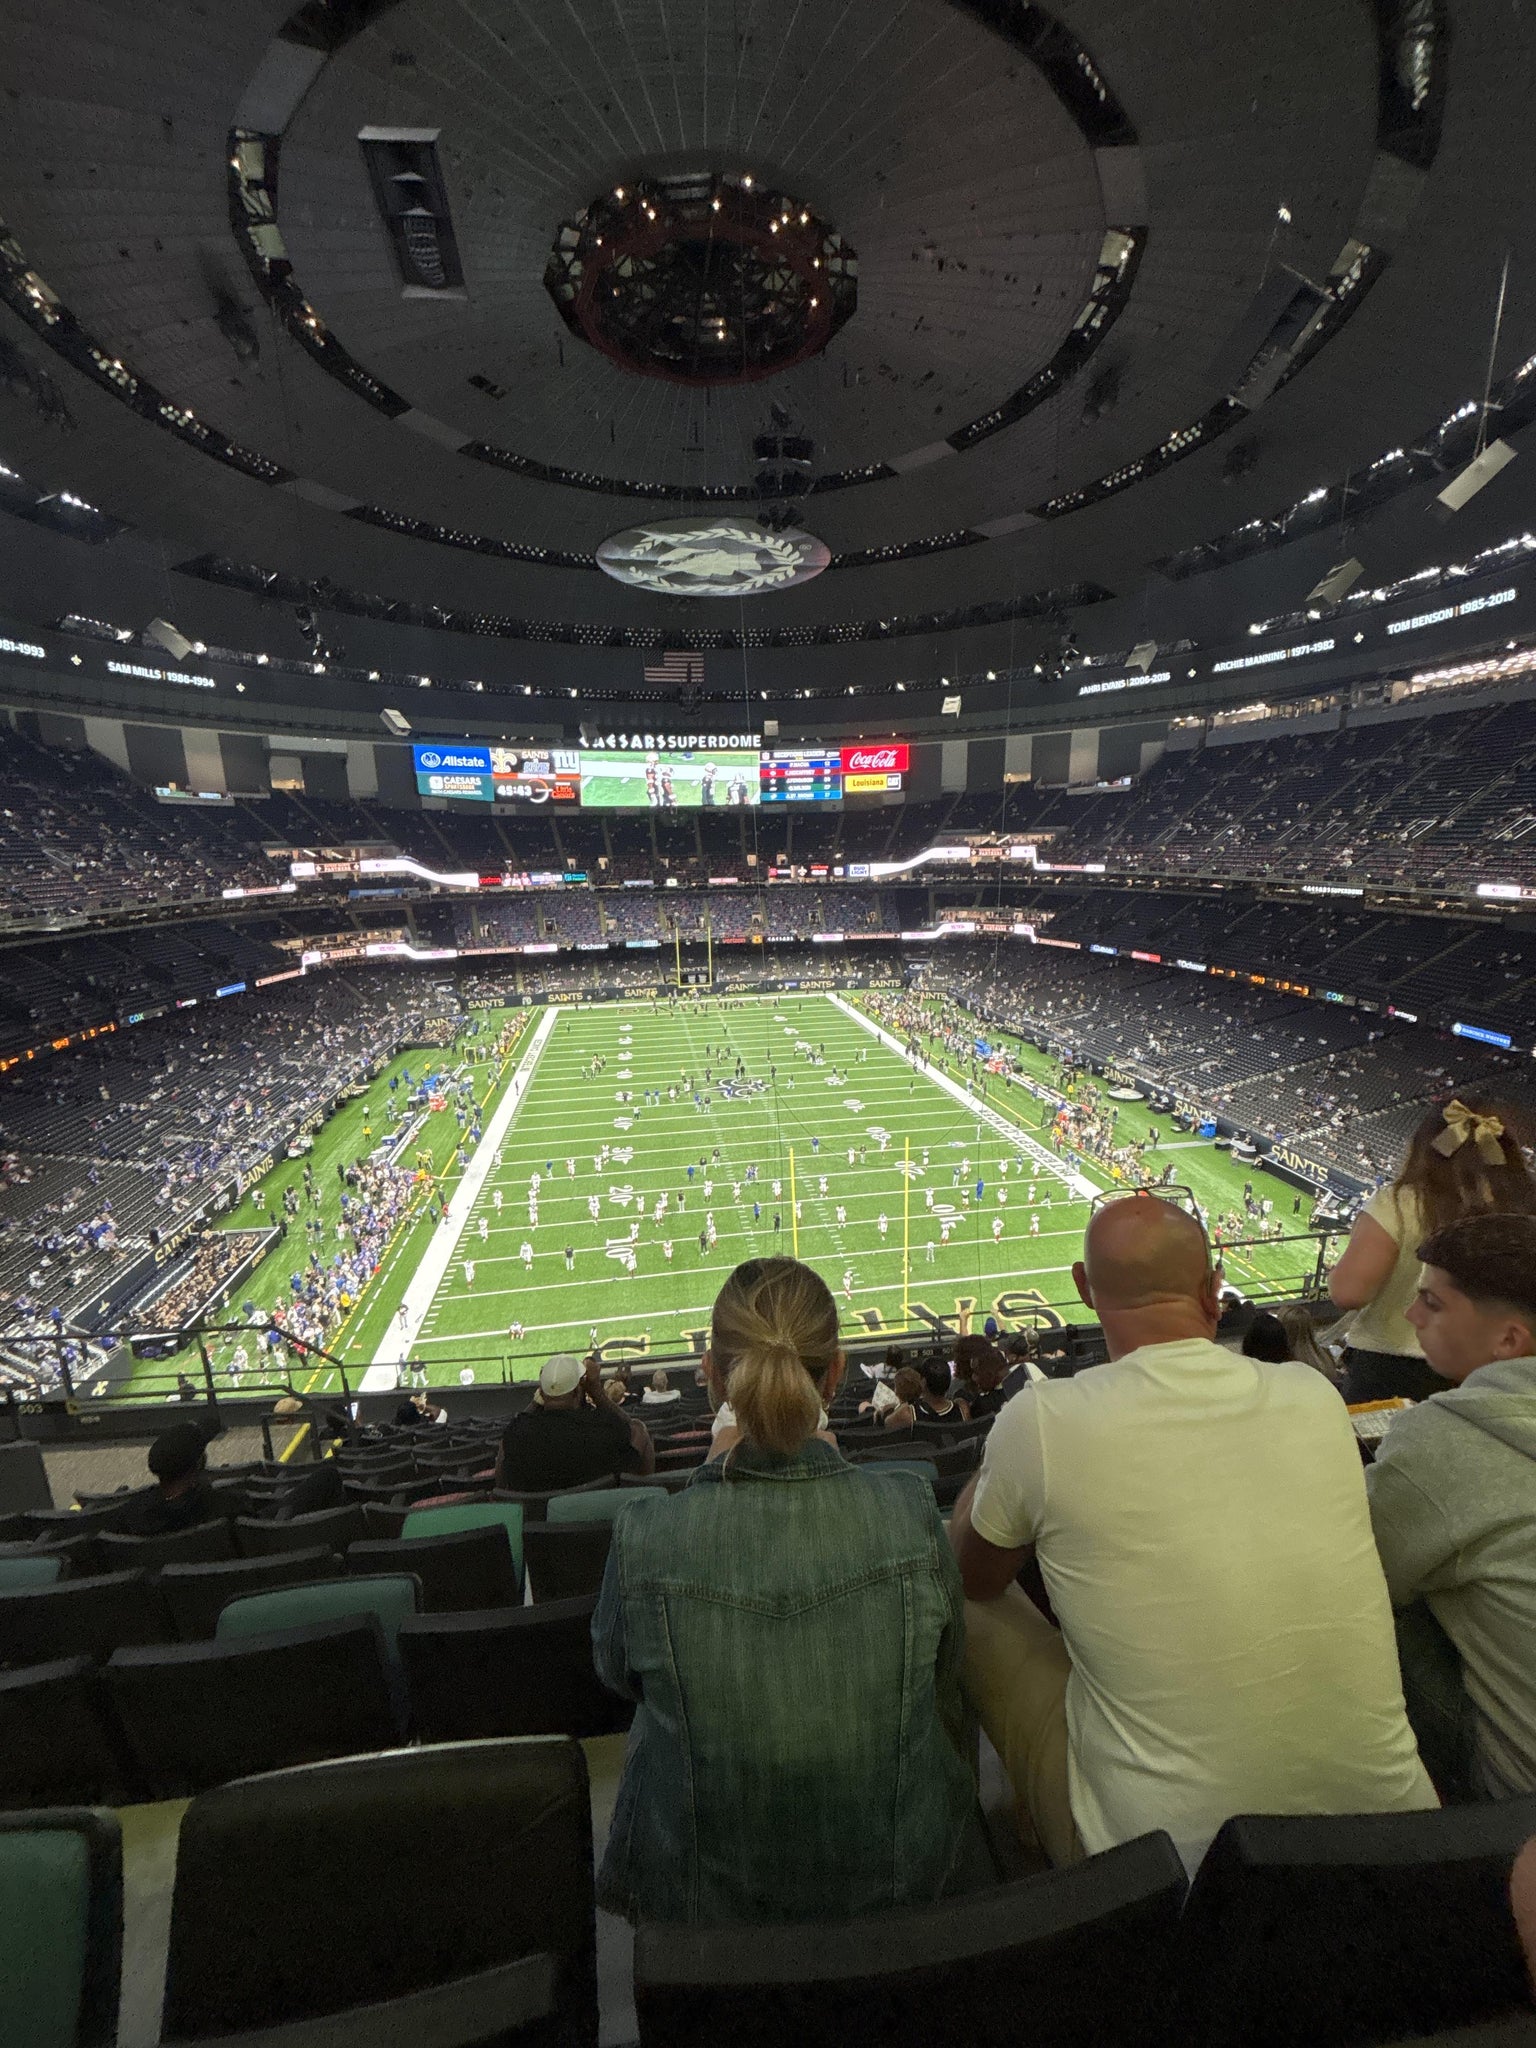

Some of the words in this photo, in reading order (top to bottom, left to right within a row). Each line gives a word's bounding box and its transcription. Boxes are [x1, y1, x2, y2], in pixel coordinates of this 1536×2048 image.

[1387, 620, 1410, 634] TOM
[1411, 607, 1454, 629] BENSON
[1459, 588, 1516, 615] 1985-2018
[1213, 658, 1244, 672] ARCHIE
[1245, 650, 1286, 667] MANNING
[1290, 639, 1335, 657] 1971-1982
[107, 661, 131, 674] SAM
[132, 665, 161, 680] MILLS
[166, 671, 216, 688] 1986-1994
[667, 734, 762, 748] SUPERDOME
[521, 751, 549, 759] SAINTS
[442, 755, 485, 767] Allstate
[443, 776, 482, 786] CAESARS
[853, 778, 884, 787] Louisiana
[868, 980, 901, 988] SAINTS
[548, 993, 583, 1002] SAINTS
[468, 999, 505, 1009] SAINTS
[128, 1012, 144, 1023] COX
[1103, 1066, 1135, 1089] SAINTS
[1271, 1145, 1329, 1183] SAINTS
